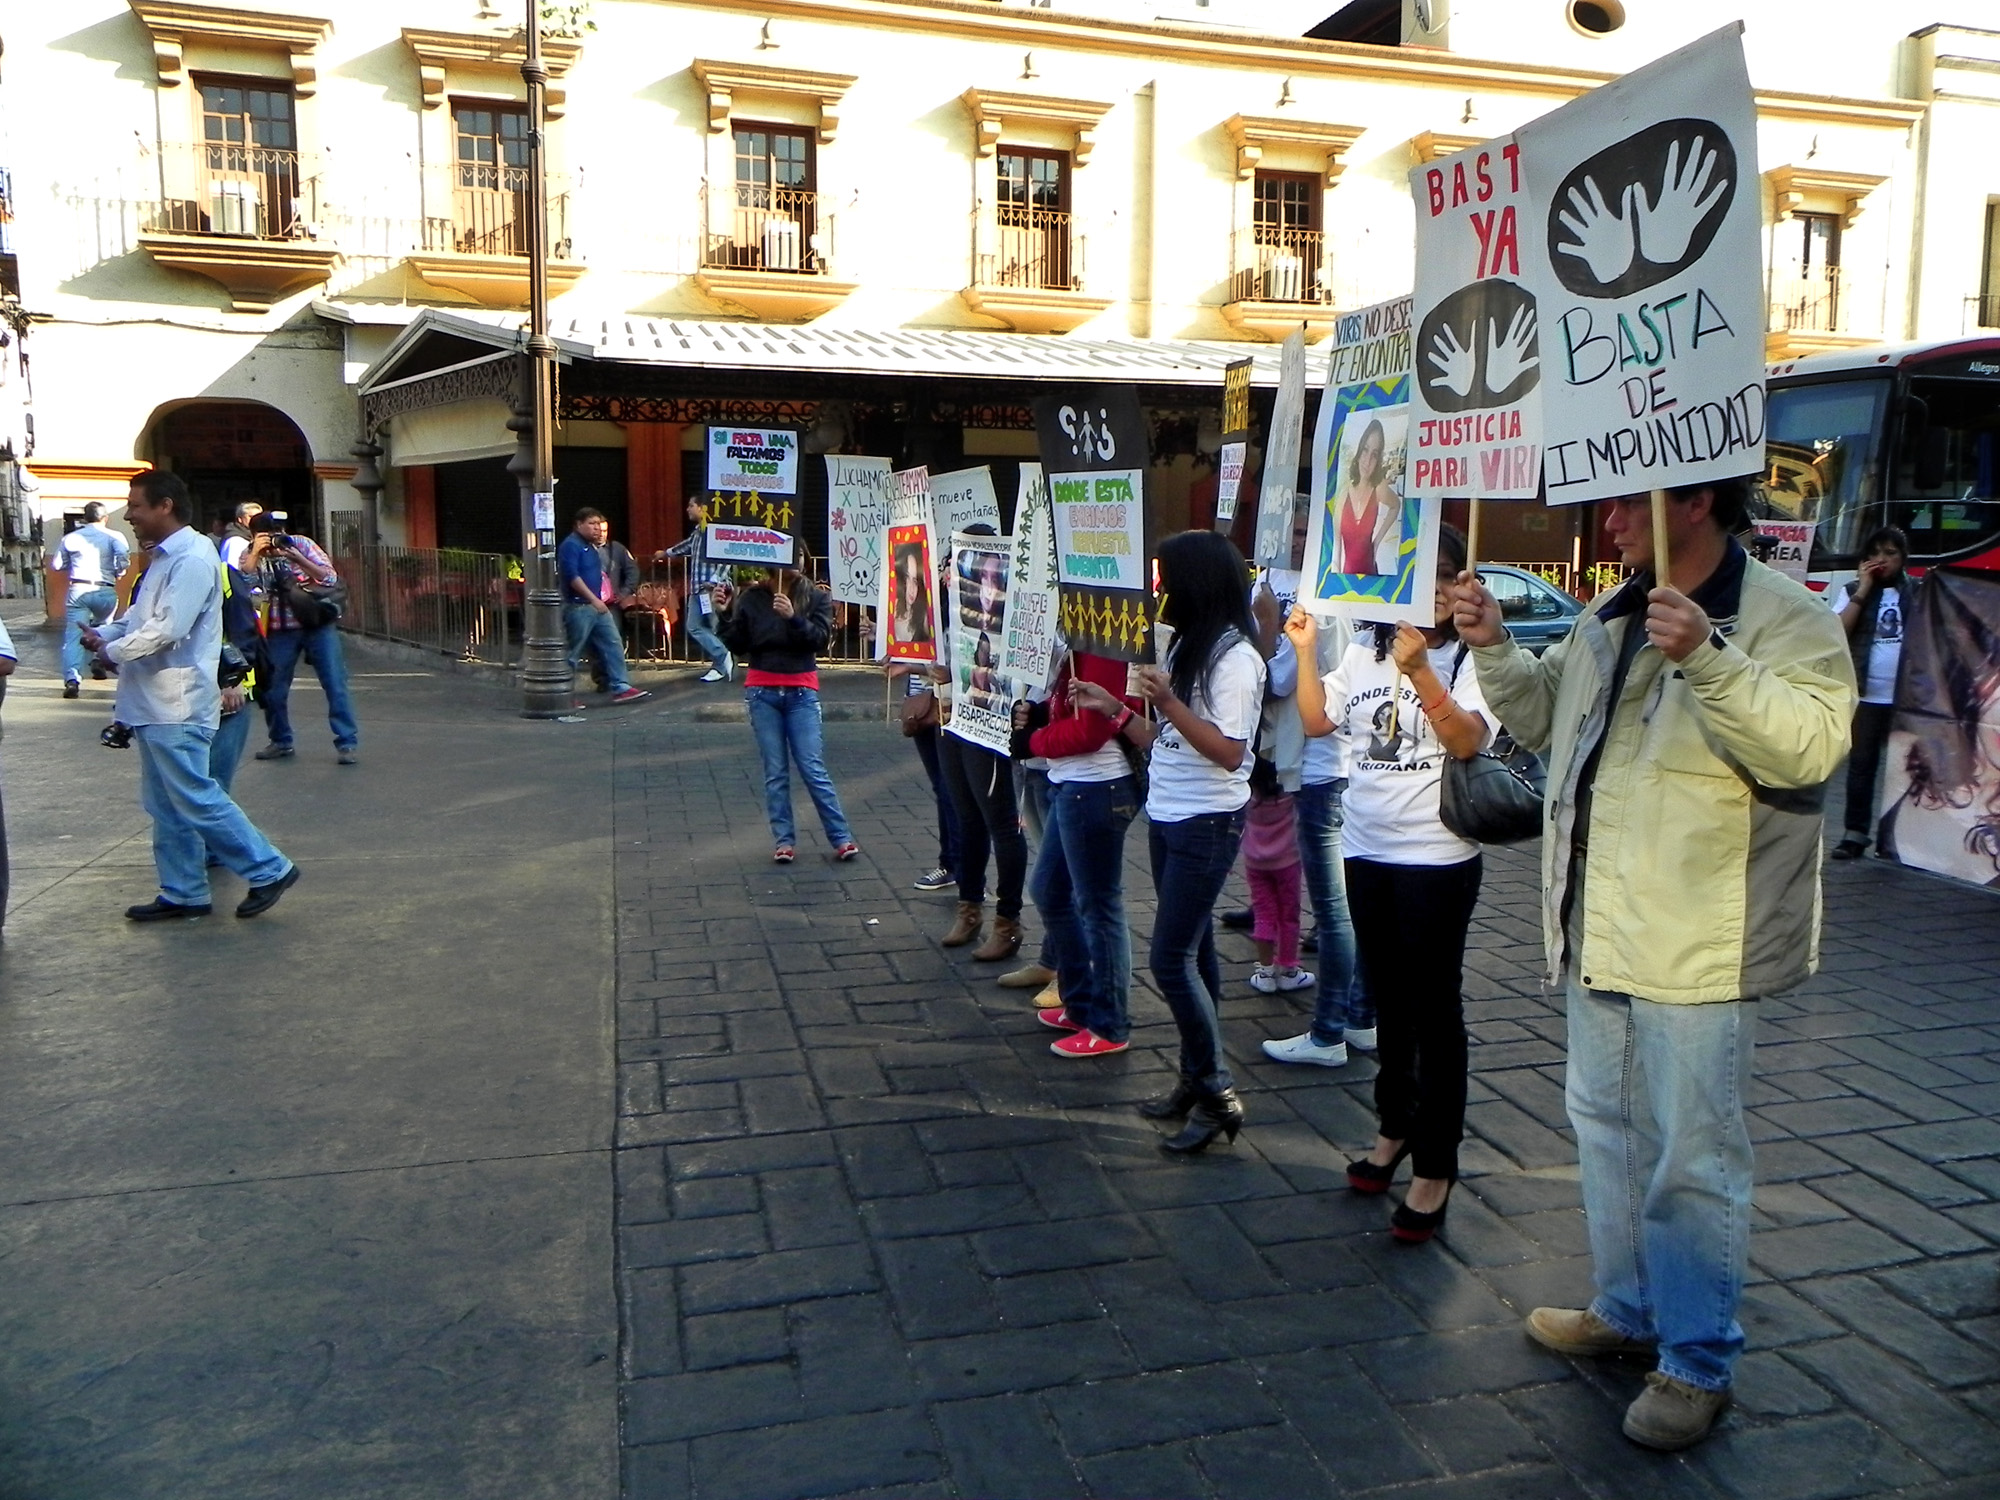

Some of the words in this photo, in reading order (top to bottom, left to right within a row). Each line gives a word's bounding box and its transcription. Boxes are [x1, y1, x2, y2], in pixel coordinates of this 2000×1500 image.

[1469, 205, 1519, 279] YA
[1363, 308, 1381, 340] NO
[1556, 288, 1735, 386] BASTA
[1329, 346, 1350, 385] TE
[1968, 361, 1999, 375] Allegro
[1617, 367, 1678, 420] DE
[731, 432, 764, 447] FALTA
[1418, 410, 1521, 447] JUSTICIA
[1547, 383, 1765, 489] IMPUNIDAD
[726, 446, 785, 462] FALTAMOS
[738, 460, 779, 475] TODOS
[1480, 445, 1536, 491] VIRI
[842, 489, 852, 508] X
[857, 491, 877, 508] LA
[938, 488, 973, 505] mueve
[1095, 472, 1134, 503] ESTÁ
[950, 502, 999, 523] montañas
[724, 542, 777, 559] JUSTICIA
[839, 534, 858, 558] NO
[865, 536, 878, 559] X
[1344, 686, 1391, 716] DONDE
